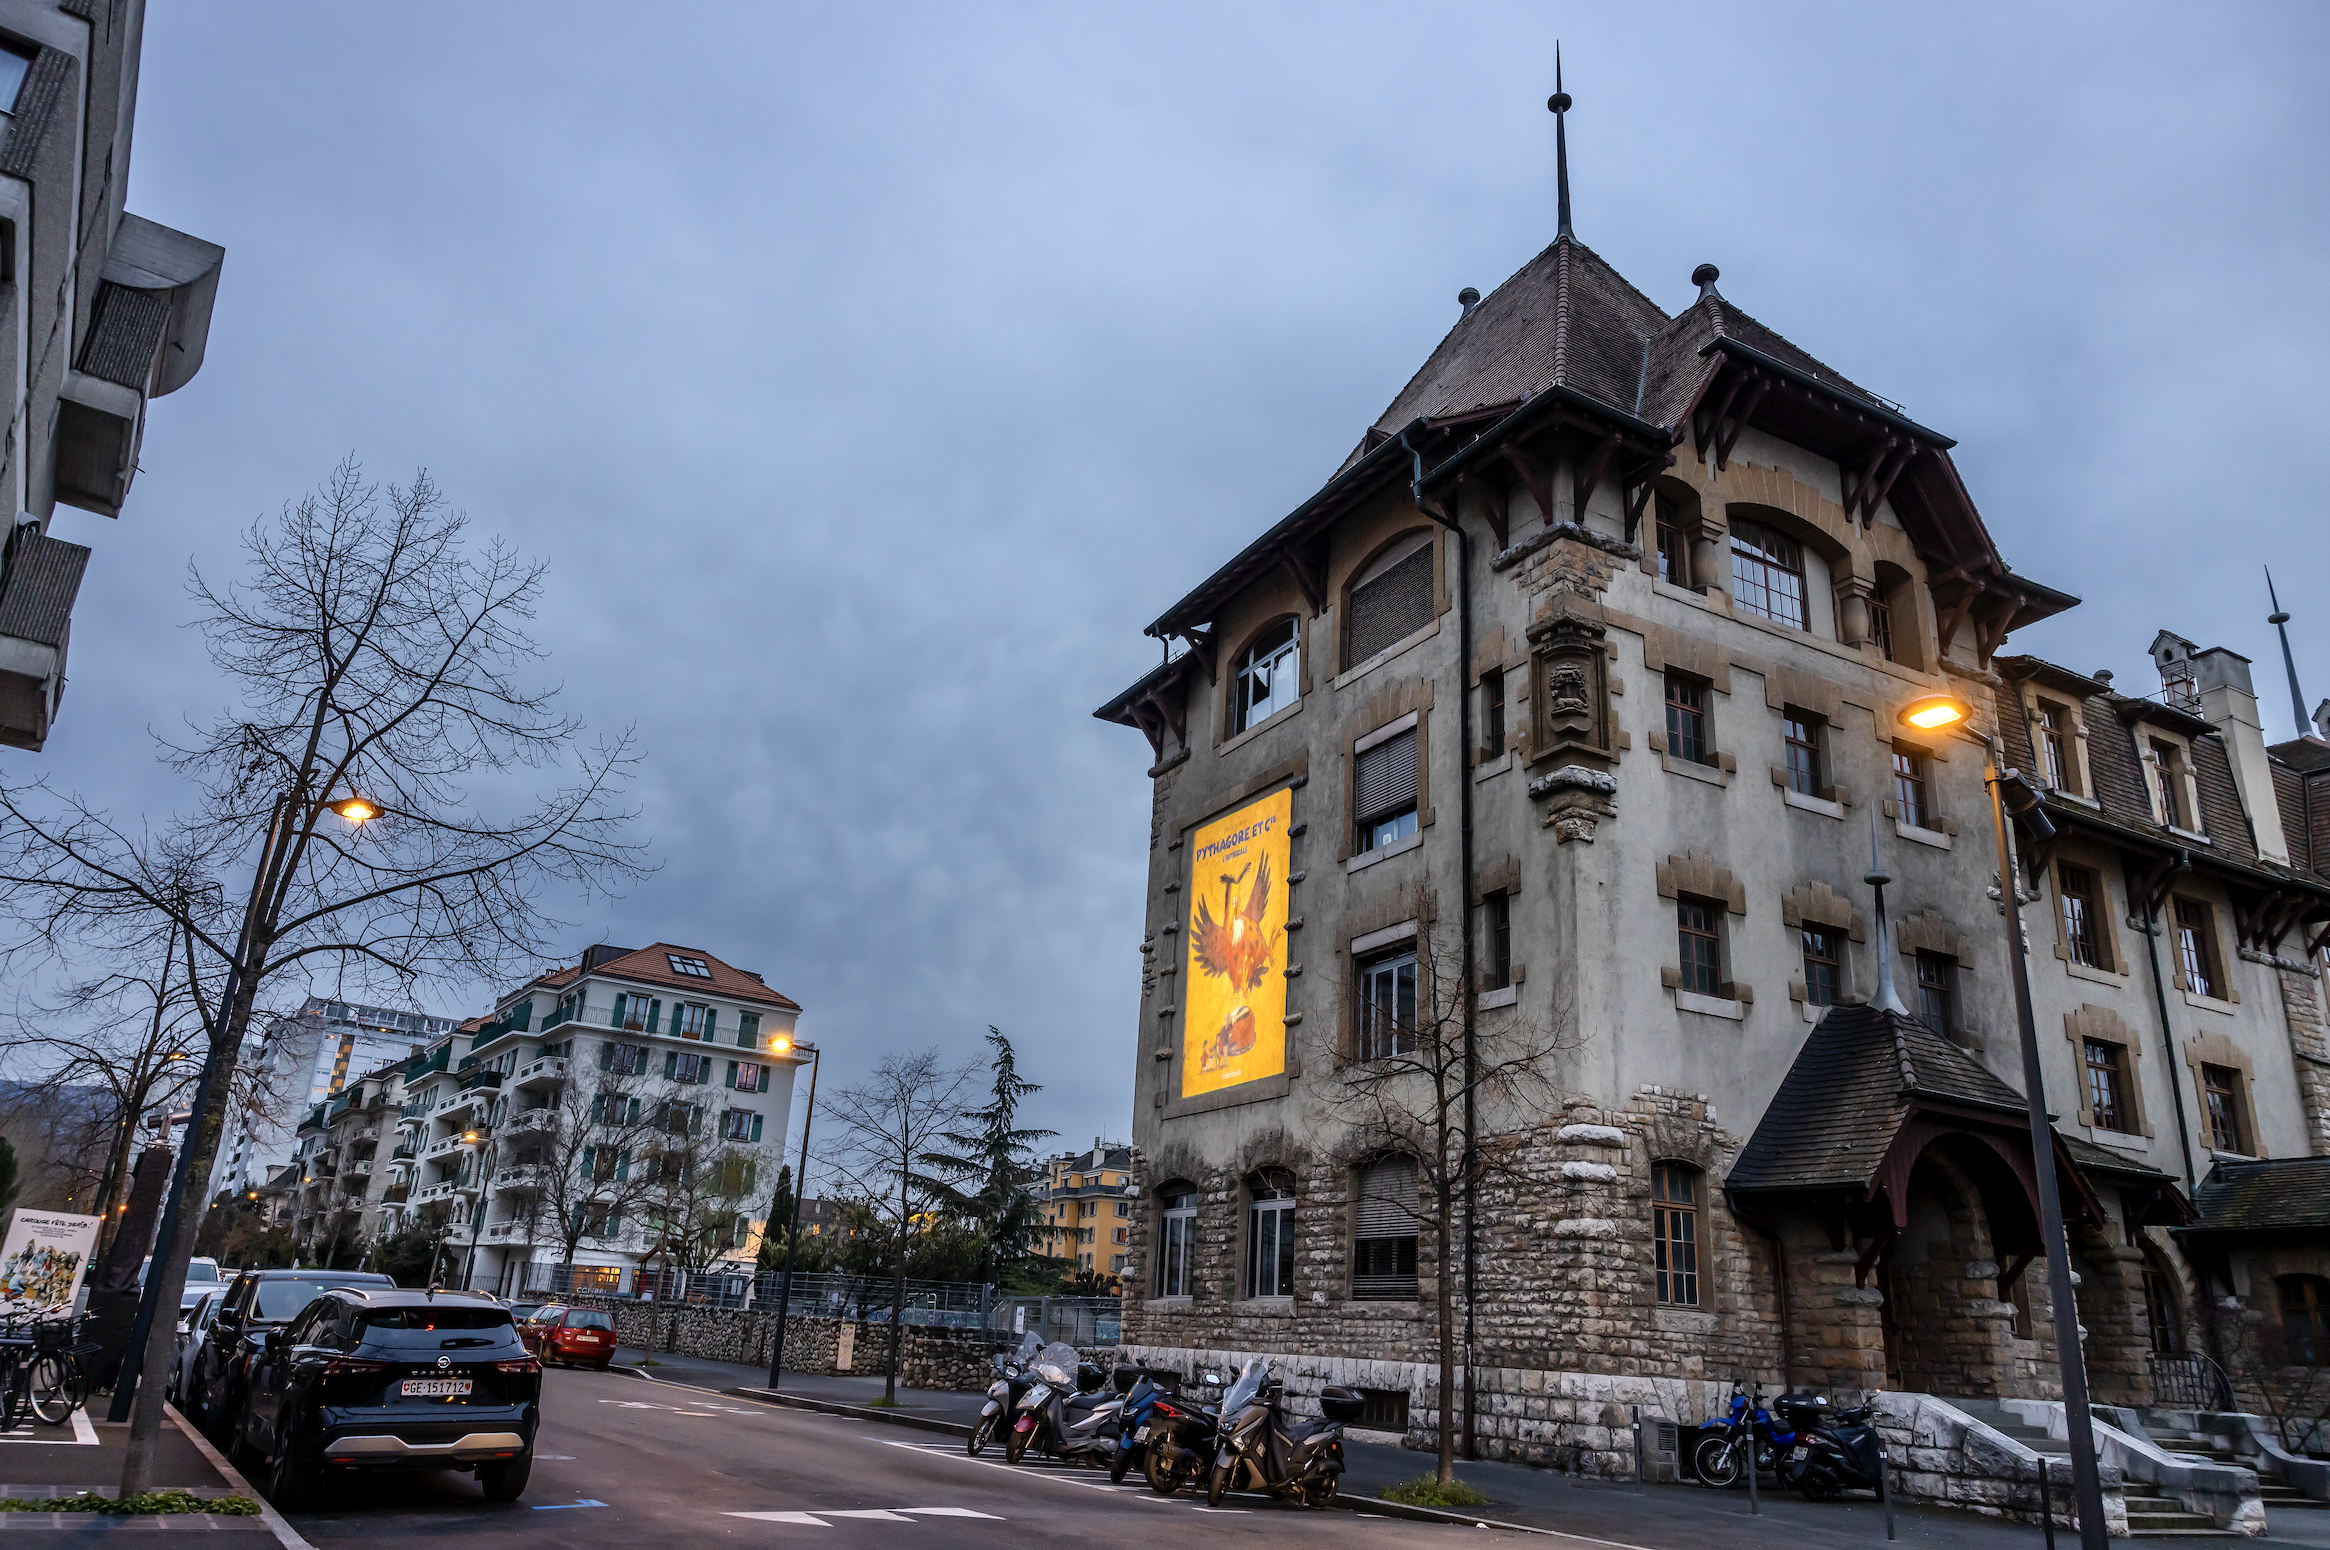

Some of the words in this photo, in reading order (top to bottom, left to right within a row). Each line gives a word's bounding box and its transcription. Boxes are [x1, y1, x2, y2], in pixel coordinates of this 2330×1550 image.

[1196, 826, 1250, 862] PYTHAGORE
[1252, 821, 1264, 838] ET
[20, 1217, 50, 1225] CAROUGE
